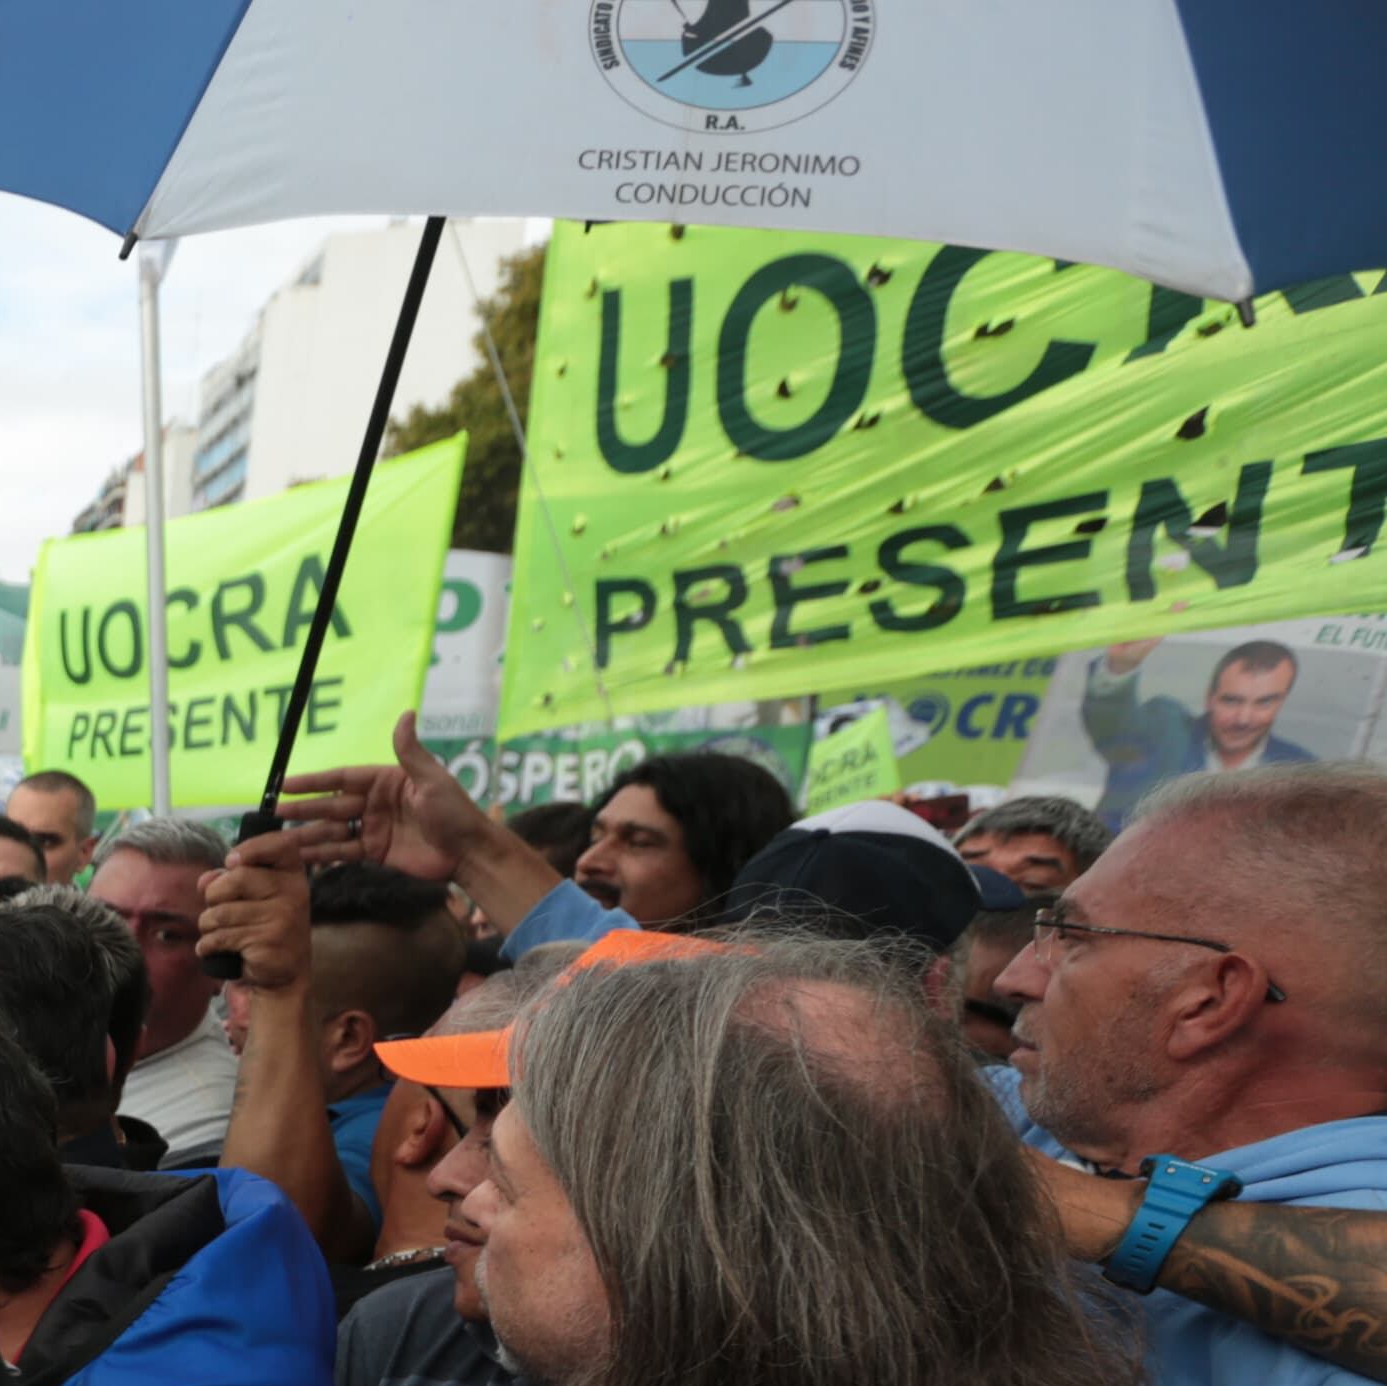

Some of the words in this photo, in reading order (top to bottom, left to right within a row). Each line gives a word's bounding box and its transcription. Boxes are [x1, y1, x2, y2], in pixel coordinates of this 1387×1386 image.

[593, 3, 620, 71] SINDICATO
[852, 16, 870, 24] Y
[839, 26, 870, 71] AFINES
[705, 114, 746, 131] R.A.
[577, 149, 703, 172] CRISTIAN
[710, 151, 861, 177] JERONIMO
[615, 181, 812, 208] CONDUCCIÓN
[596, 244, 1387, 474] UOC
[595, 437, 1387, 667] PRESENT
[60, 552, 352, 686] UOCRA
[439, 741, 646, 807] ÓSPERO
